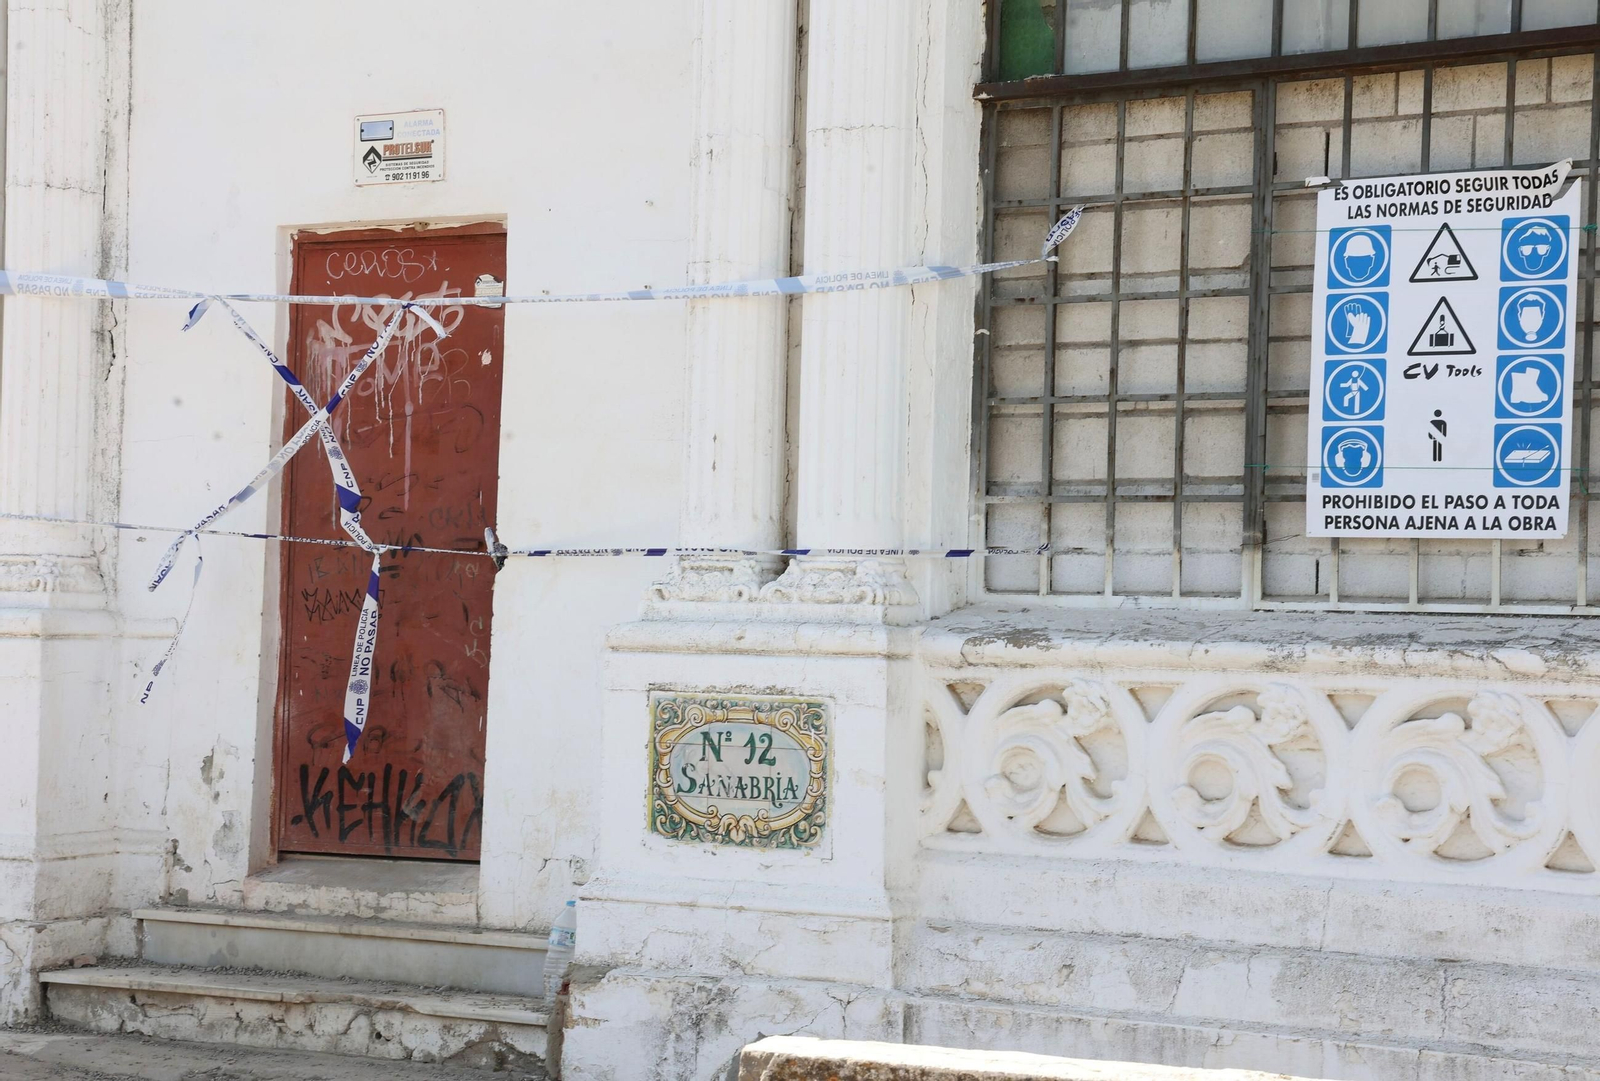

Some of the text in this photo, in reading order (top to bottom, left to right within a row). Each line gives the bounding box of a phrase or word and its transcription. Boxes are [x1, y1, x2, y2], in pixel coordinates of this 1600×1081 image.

[397, 129, 440, 137] CONECTADA
[404, 120, 434, 128] ALARMA
[383, 141, 432, 155] PROTELSUR
[1334, 170, 1559, 201] ES OBLIGATORIO SEGUIR TODAS
[1347, 193, 1553, 220] LAS NORMAS DE SEGURIDAD
[1403, 362, 1482, 380] CV Tools
[325, 426, 353, 488] CNP NO
[1322, 494, 1560, 510] PROHIBIDO EL PASO A TODA
[344, 521, 366, 545] POLICIA
[1324, 515, 1557, 531] PERSONA AJENA A LA OBRA
[352, 608, 369, 677] LINEA DE POLICIA
[359, 656, 370, 676] NO
[356, 698, 365, 725] CNP
[744, 732, 776, 766] 12
[676, 762, 799, 808] SANABRIA
